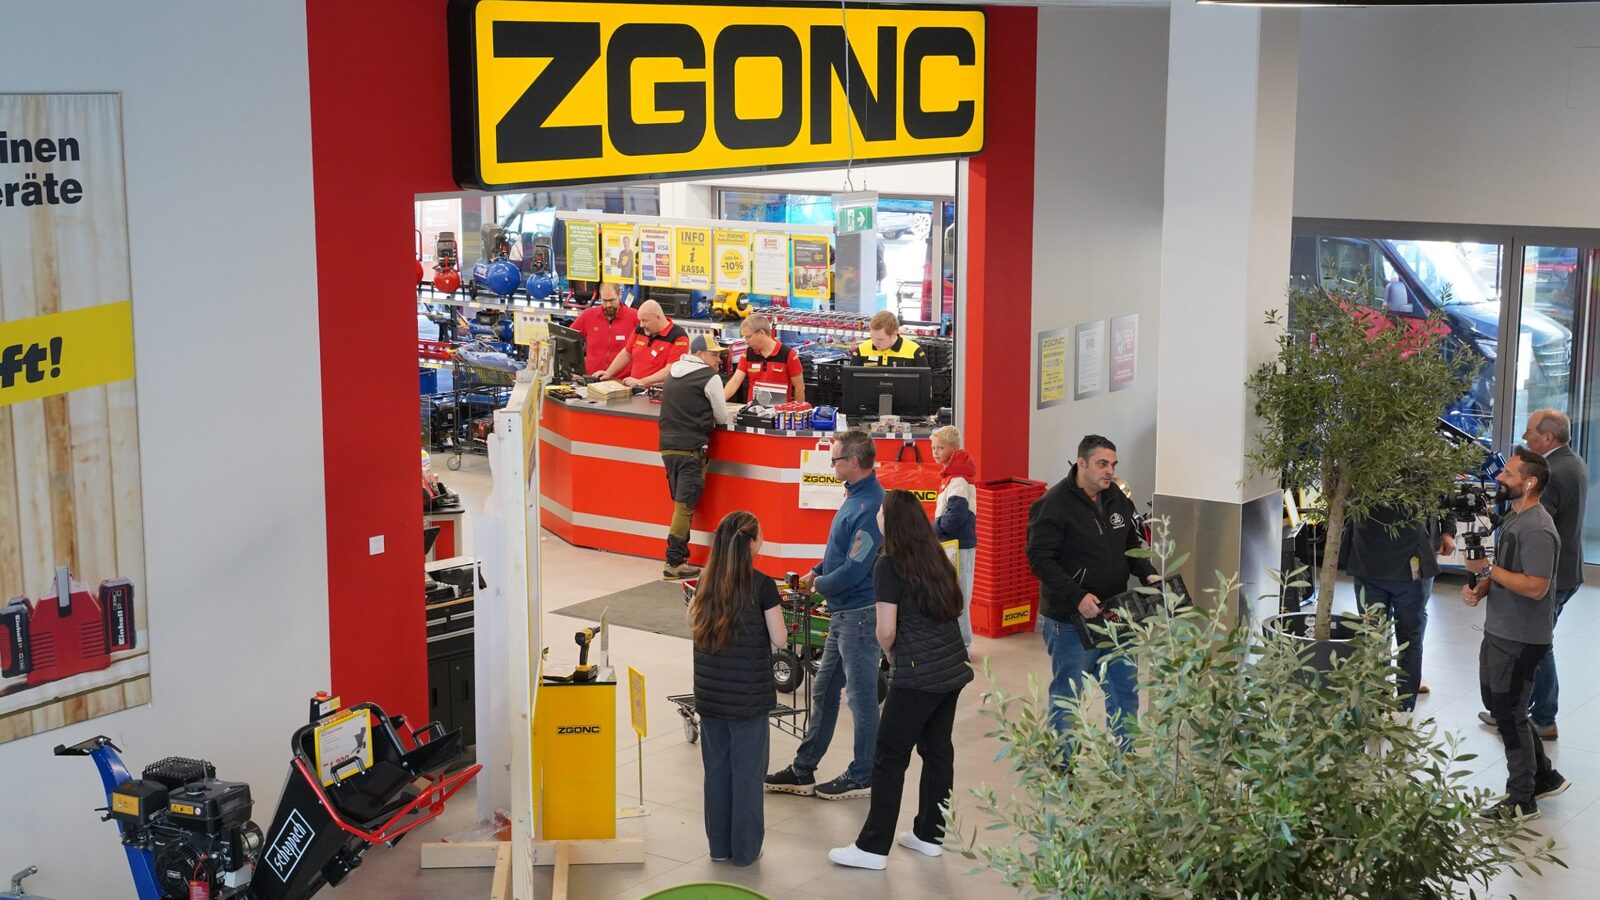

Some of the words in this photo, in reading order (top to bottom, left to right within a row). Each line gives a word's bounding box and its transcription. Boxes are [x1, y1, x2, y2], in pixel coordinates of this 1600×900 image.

[492, 20, 976, 164] ZGONC
[0, 173, 83, 207] räte
[681, 231, 705, 243] INFO
[681, 264, 705, 274] KASSA
[721, 261, 744, 270] -10%
[1004, 610, 1029, 621] ZGONC
[117, 610, 125, 646] Einhell
[557, 726, 600, 735] ZGONC
[273, 816, 307, 873] scheppach
